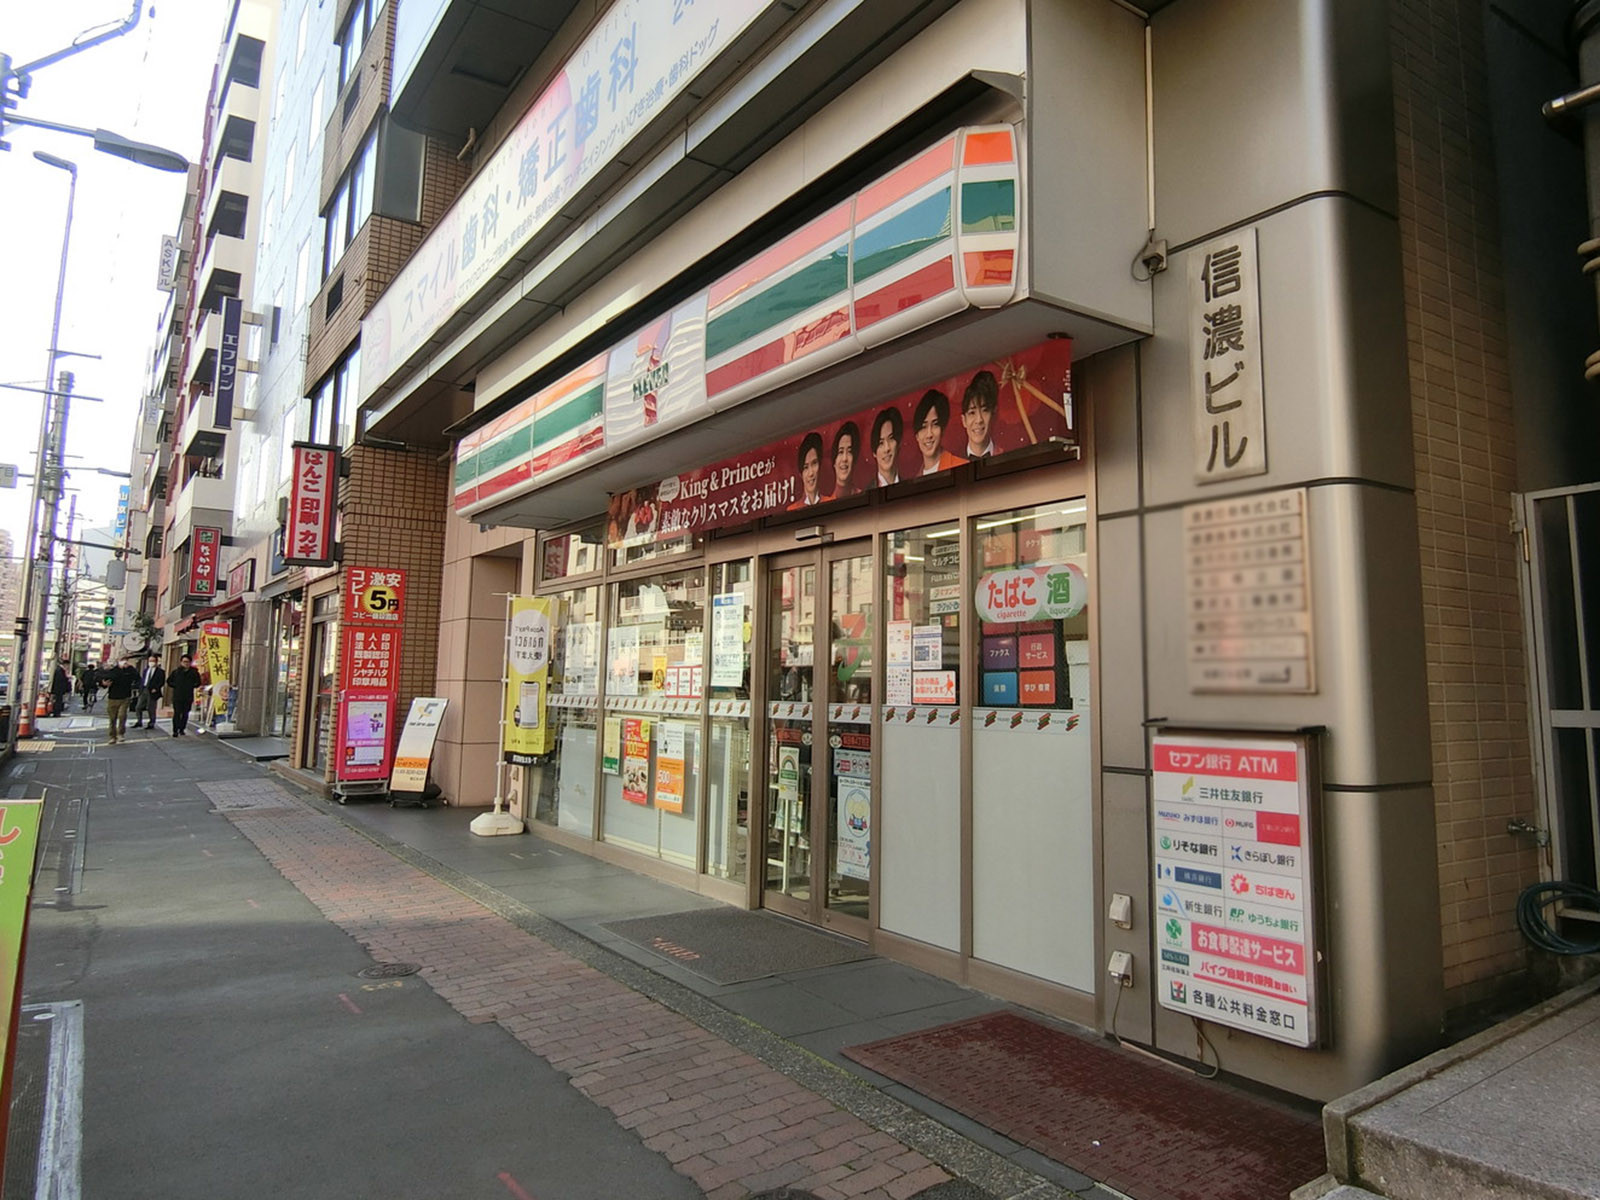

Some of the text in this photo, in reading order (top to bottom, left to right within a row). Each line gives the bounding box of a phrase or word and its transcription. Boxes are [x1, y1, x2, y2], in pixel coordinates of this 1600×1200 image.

[1201, 244, 1248, 472] 信濃ビル
[302, 451, 323, 493] はんこ
[679, 477, 708, 501] King
[661, 475, 796, 534] 素敵なクリスマスをお届け!
[297, 529, 318, 558] カギ
[352, 570, 366, 609] コピー
[370, 572, 401, 587] 激安
[1047, 572, 1070, 604] 酒
[370, 590, 399, 611] 5円
[988, 576, 1037, 609] たばこ
[997, 609, 1027, 619] cigarette
[1169, 750, 1278, 774] セブン銀行 ATM
[1199, 787, 1264, 804] 三井住友銀行
[1183, 814, 1219, 826] みずほ銀行
[1235, 821, 1254, 829] MUFG
[1173, 840, 1218, 857] りそな銀行
[1185, 900, 1223, 918] 新生銀行
[1248, 914, 1299, 932] ゆうちょ銀行
[1198, 930, 1297, 967] お食事配達サービス
[1193, 989, 1295, 1030] 各種公共料金窓口
